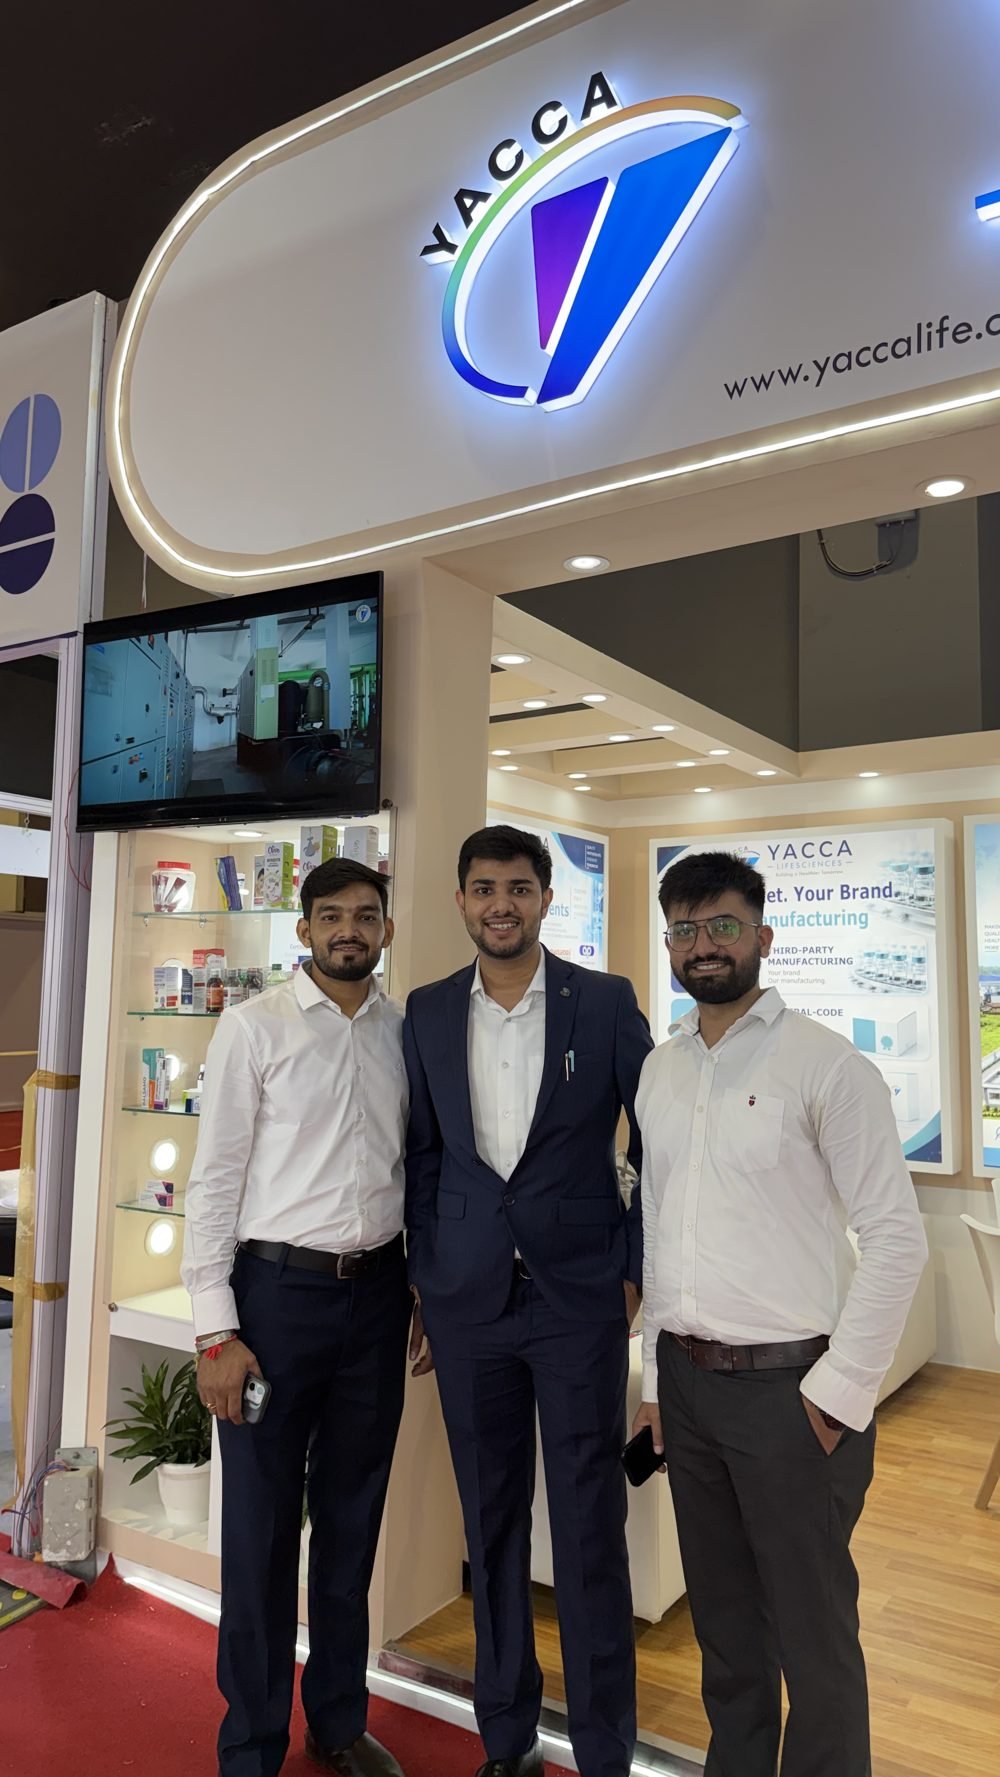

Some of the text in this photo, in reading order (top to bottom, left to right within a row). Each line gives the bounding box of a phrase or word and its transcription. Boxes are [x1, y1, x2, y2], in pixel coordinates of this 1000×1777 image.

[419, 70, 619, 258] YACCA
[767, 839, 853, 861] YACCA
[776, 859, 842, 871] LIFESCIENCES
[764, 887, 788, 903] et.
[793, 885, 834, 902] Your
[770, 946, 834, 955] HIRD-PARTY
[767, 956, 854, 966] MANUFACTURING
